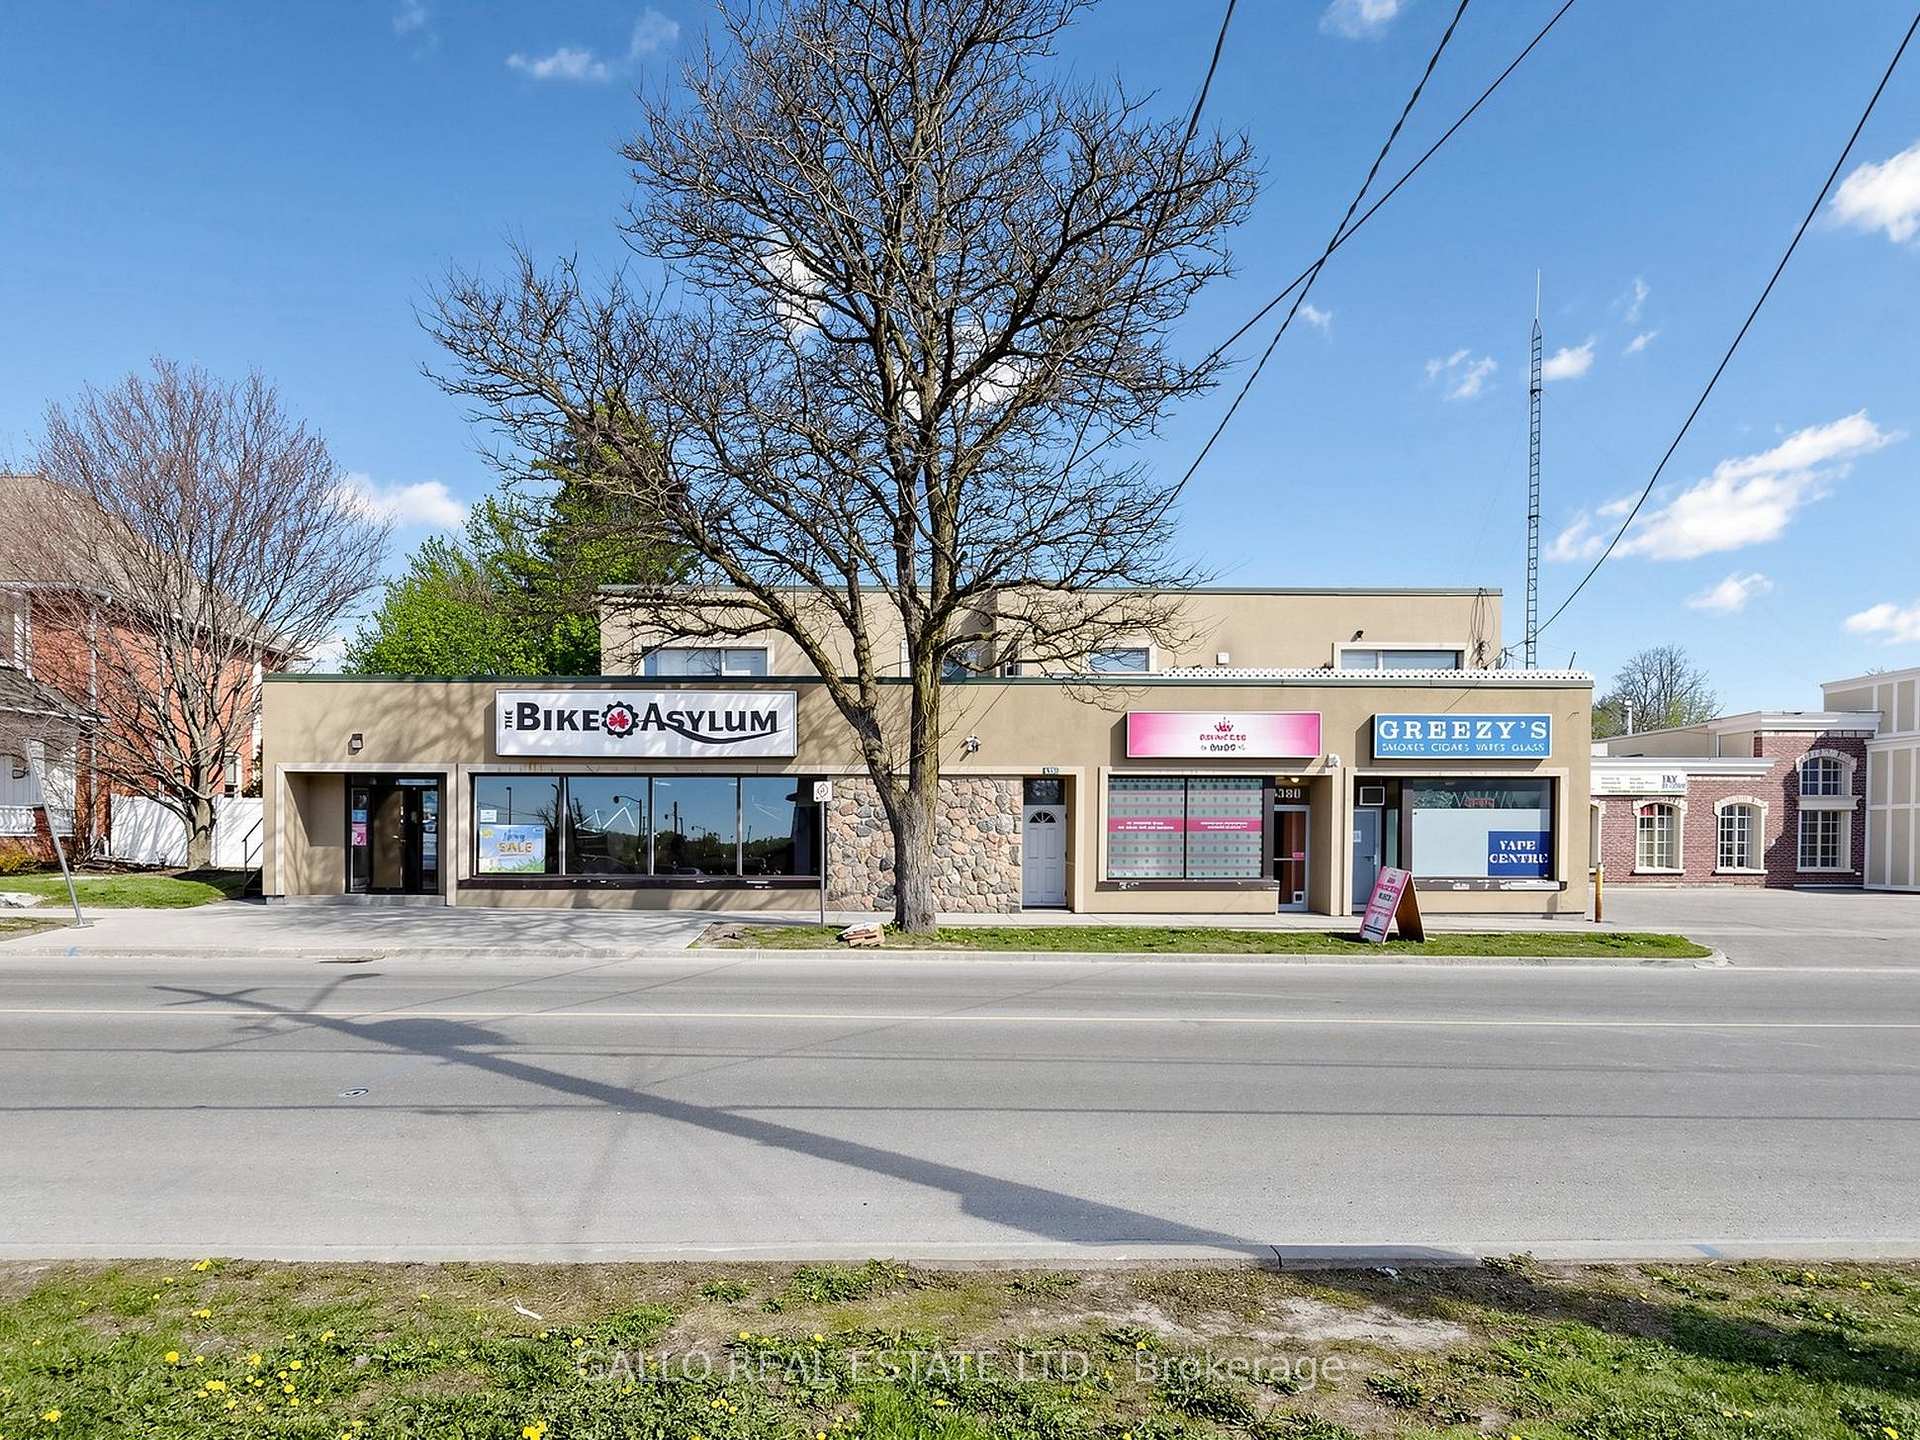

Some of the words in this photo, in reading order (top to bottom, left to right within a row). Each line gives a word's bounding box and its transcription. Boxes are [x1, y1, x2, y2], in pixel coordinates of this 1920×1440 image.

[516, 702, 600, 731] BIKE
[640, 703, 778, 732] ASYLUM
[1379, 720, 1547, 740] GREEZY'S
[498, 842, 533, 853] SALE
[1500, 840, 1536, 851] VAPE
[1489, 853, 1548, 864] CENTRE
